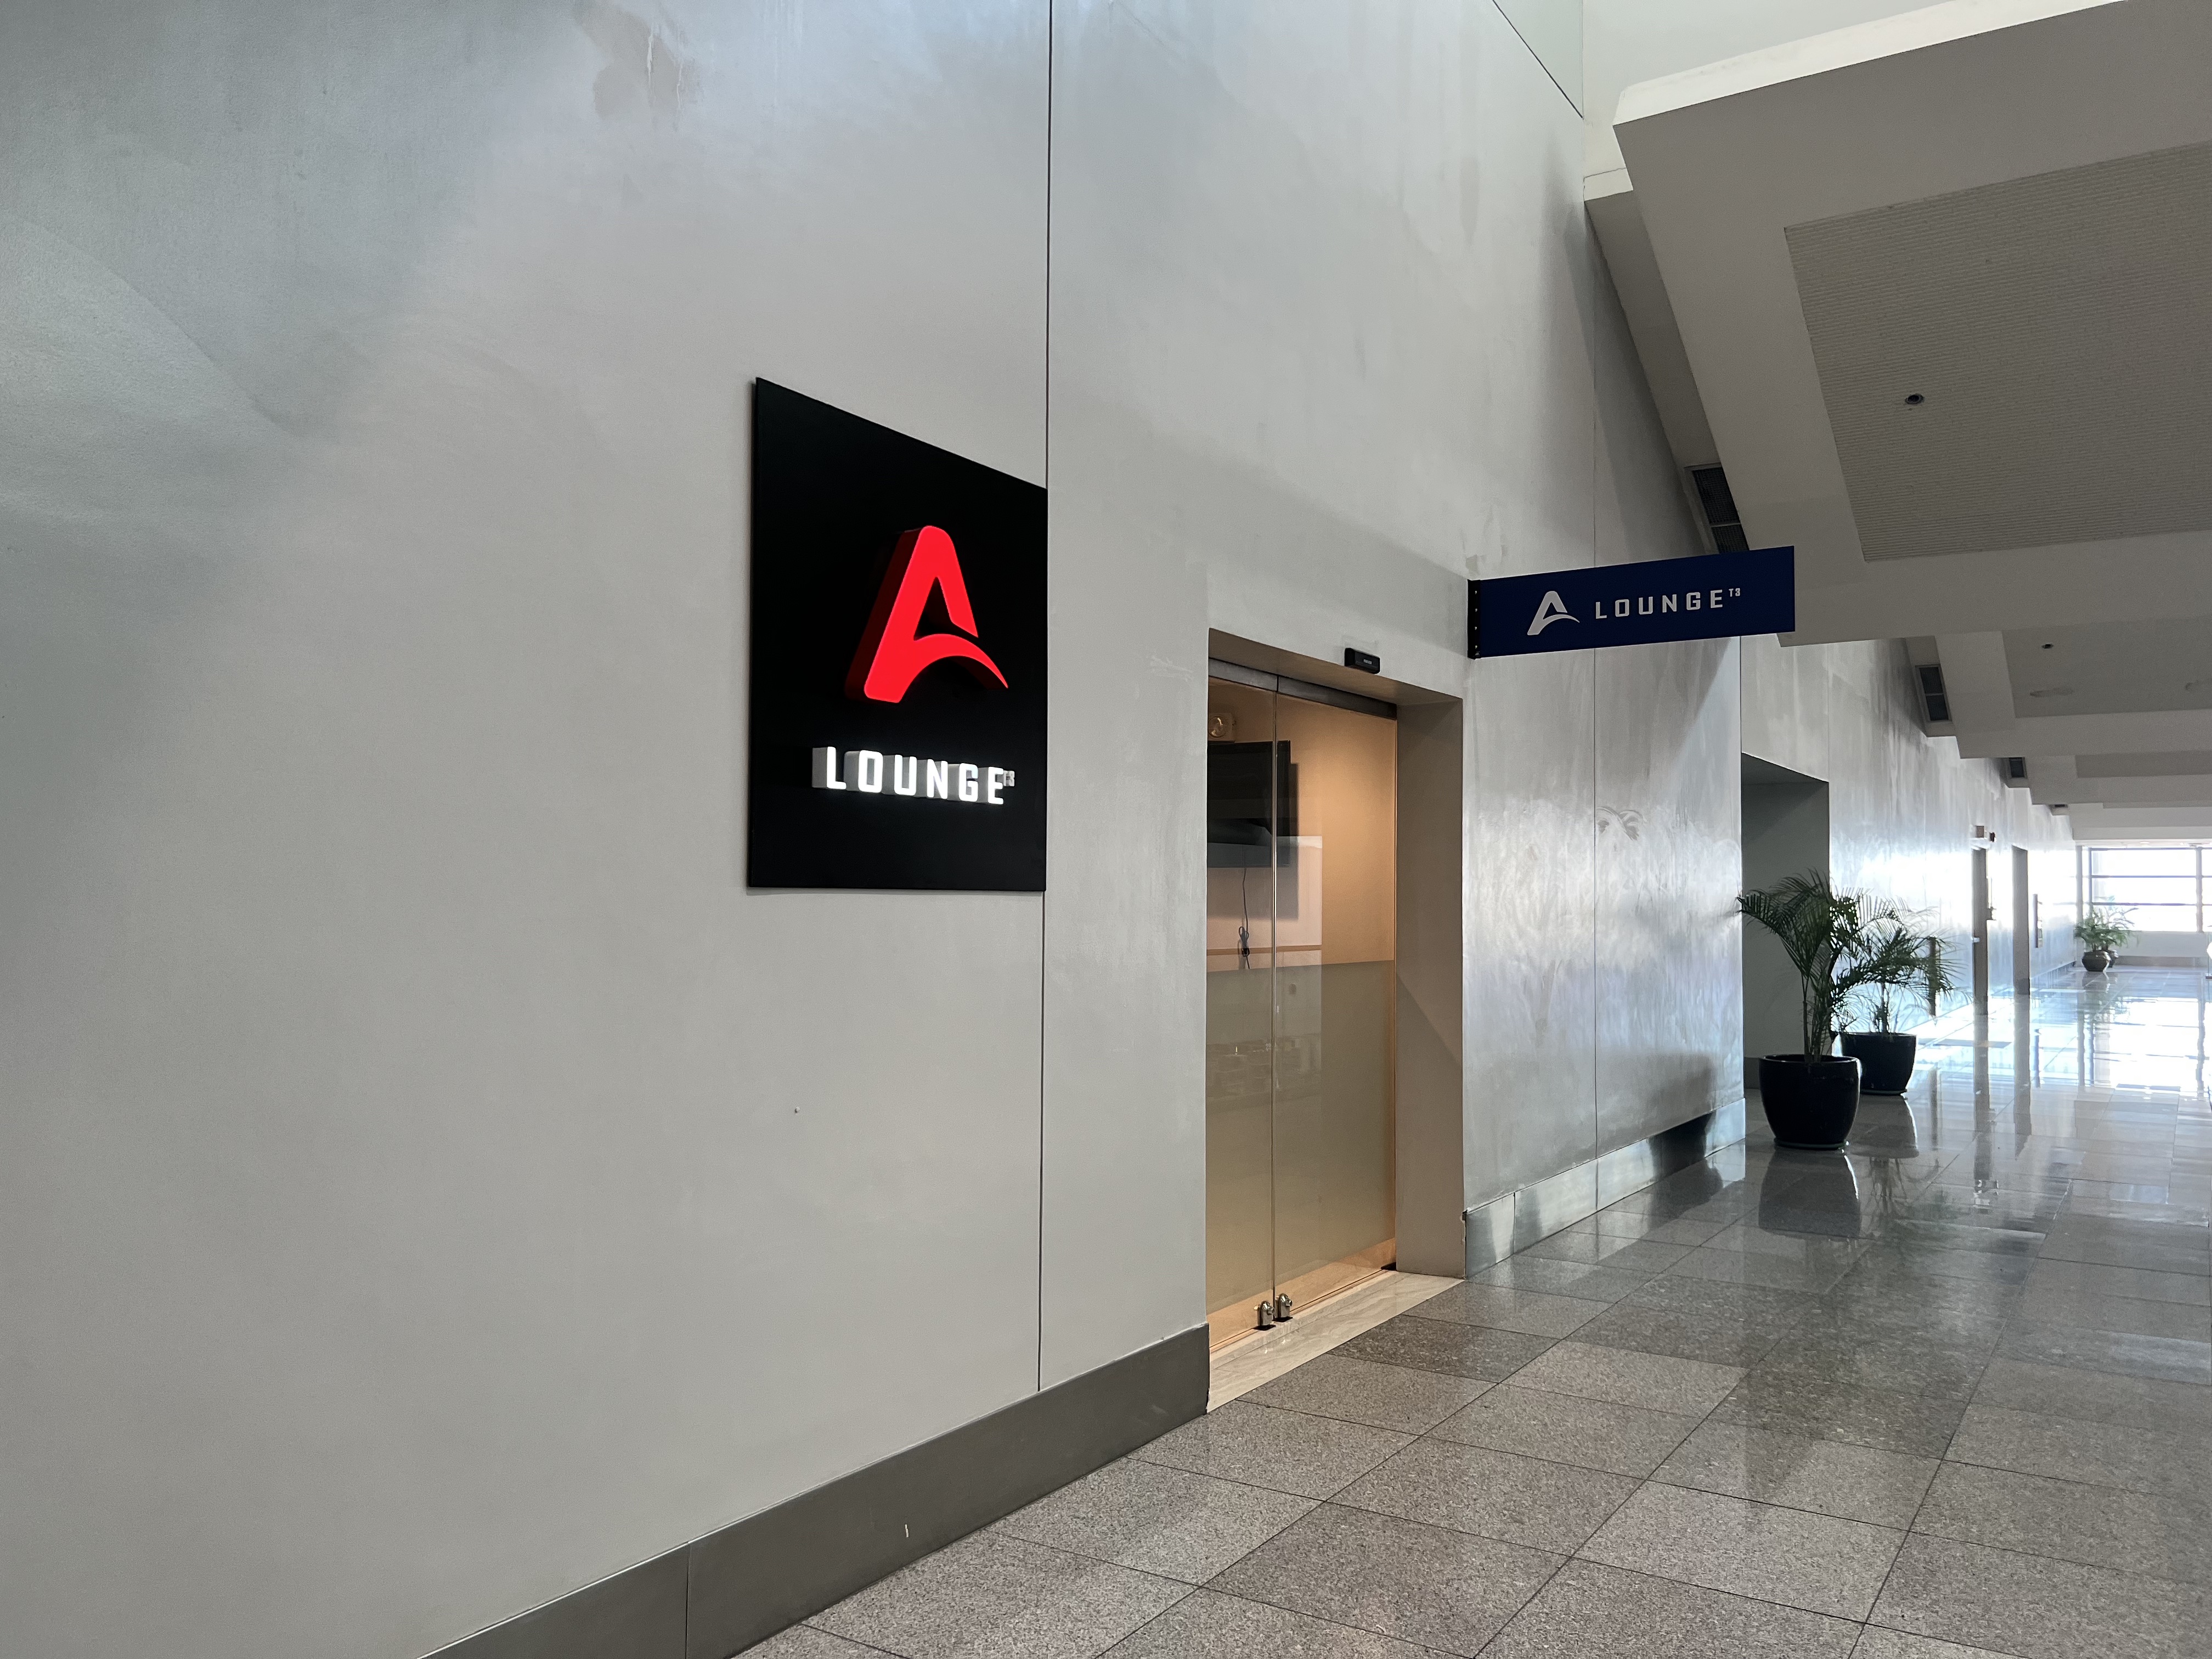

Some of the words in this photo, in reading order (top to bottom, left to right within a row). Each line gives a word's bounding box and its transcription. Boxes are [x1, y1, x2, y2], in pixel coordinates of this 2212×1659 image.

[864, 525, 1008, 703] A
[1595, 589, 1723, 620] LOUNGE
[1728, 588, 1741, 597] T3
[826, 746, 1004, 805] LOUNGE
